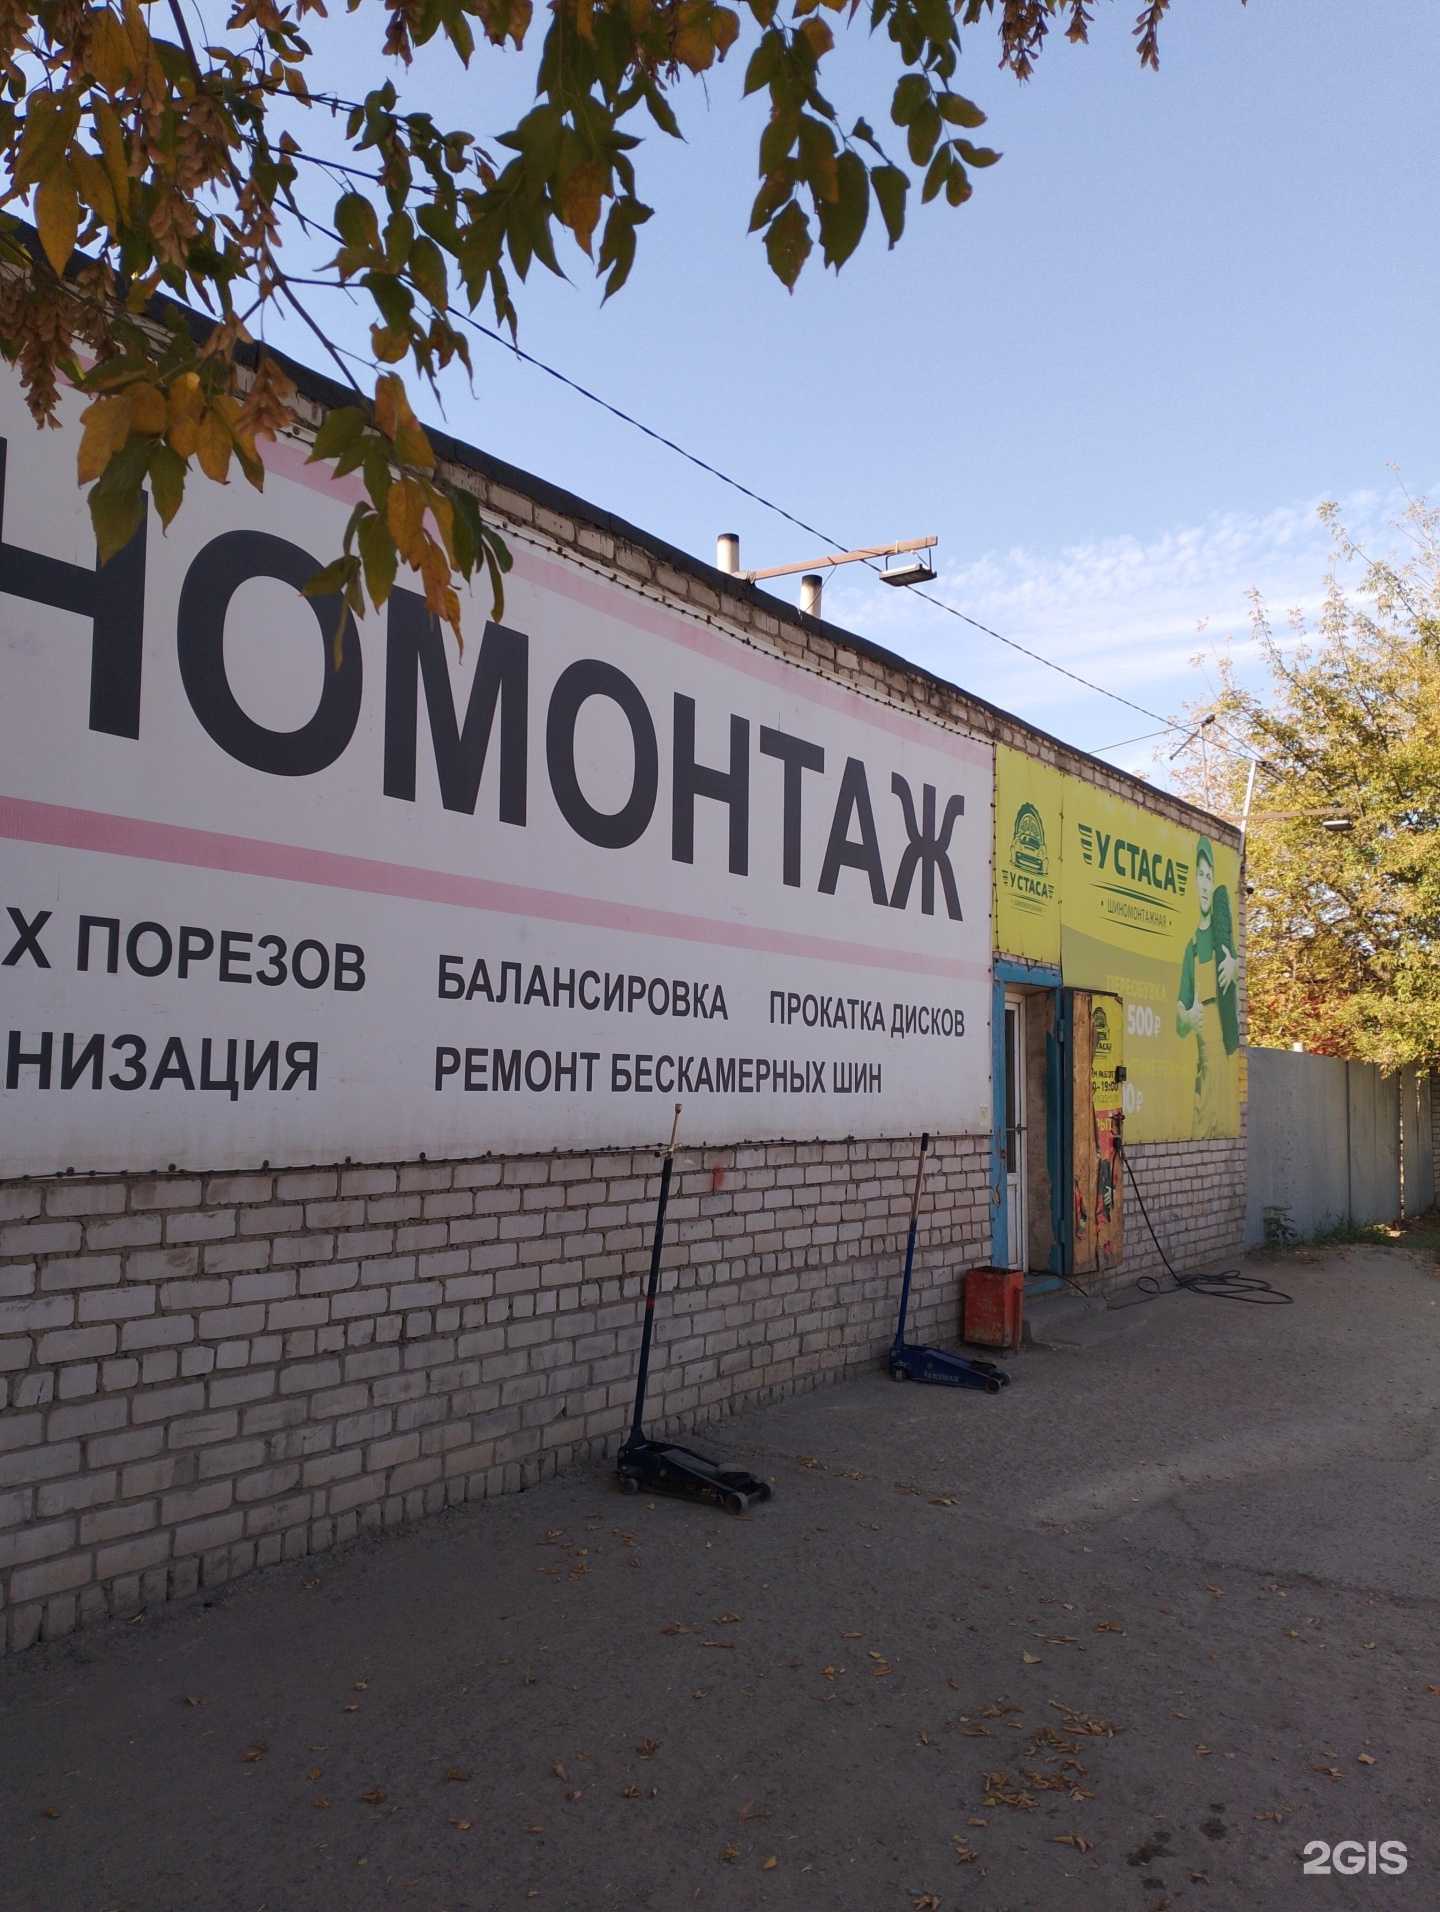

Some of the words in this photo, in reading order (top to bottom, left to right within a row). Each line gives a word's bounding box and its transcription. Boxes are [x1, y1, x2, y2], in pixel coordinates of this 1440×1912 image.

[1, 907, 53, 969] Х
[77, 914, 366, 992] ПОРЕЗОВ
[438, 955, 729, 1021] БАЛАНСИРОВКА
[770, 990, 886, 1032] ПРОКАТКА
[891, 1003, 965, 1039] ДИСКОВ
[6, 1030, 319, 1102] НИЗАЦИЯ
[434, 1046, 600, 1093] РЕМОНТ
[611, 1053, 826, 1093] БЕСКАМЕРНЫХ
[833, 1061, 882, 1094] ШИН
